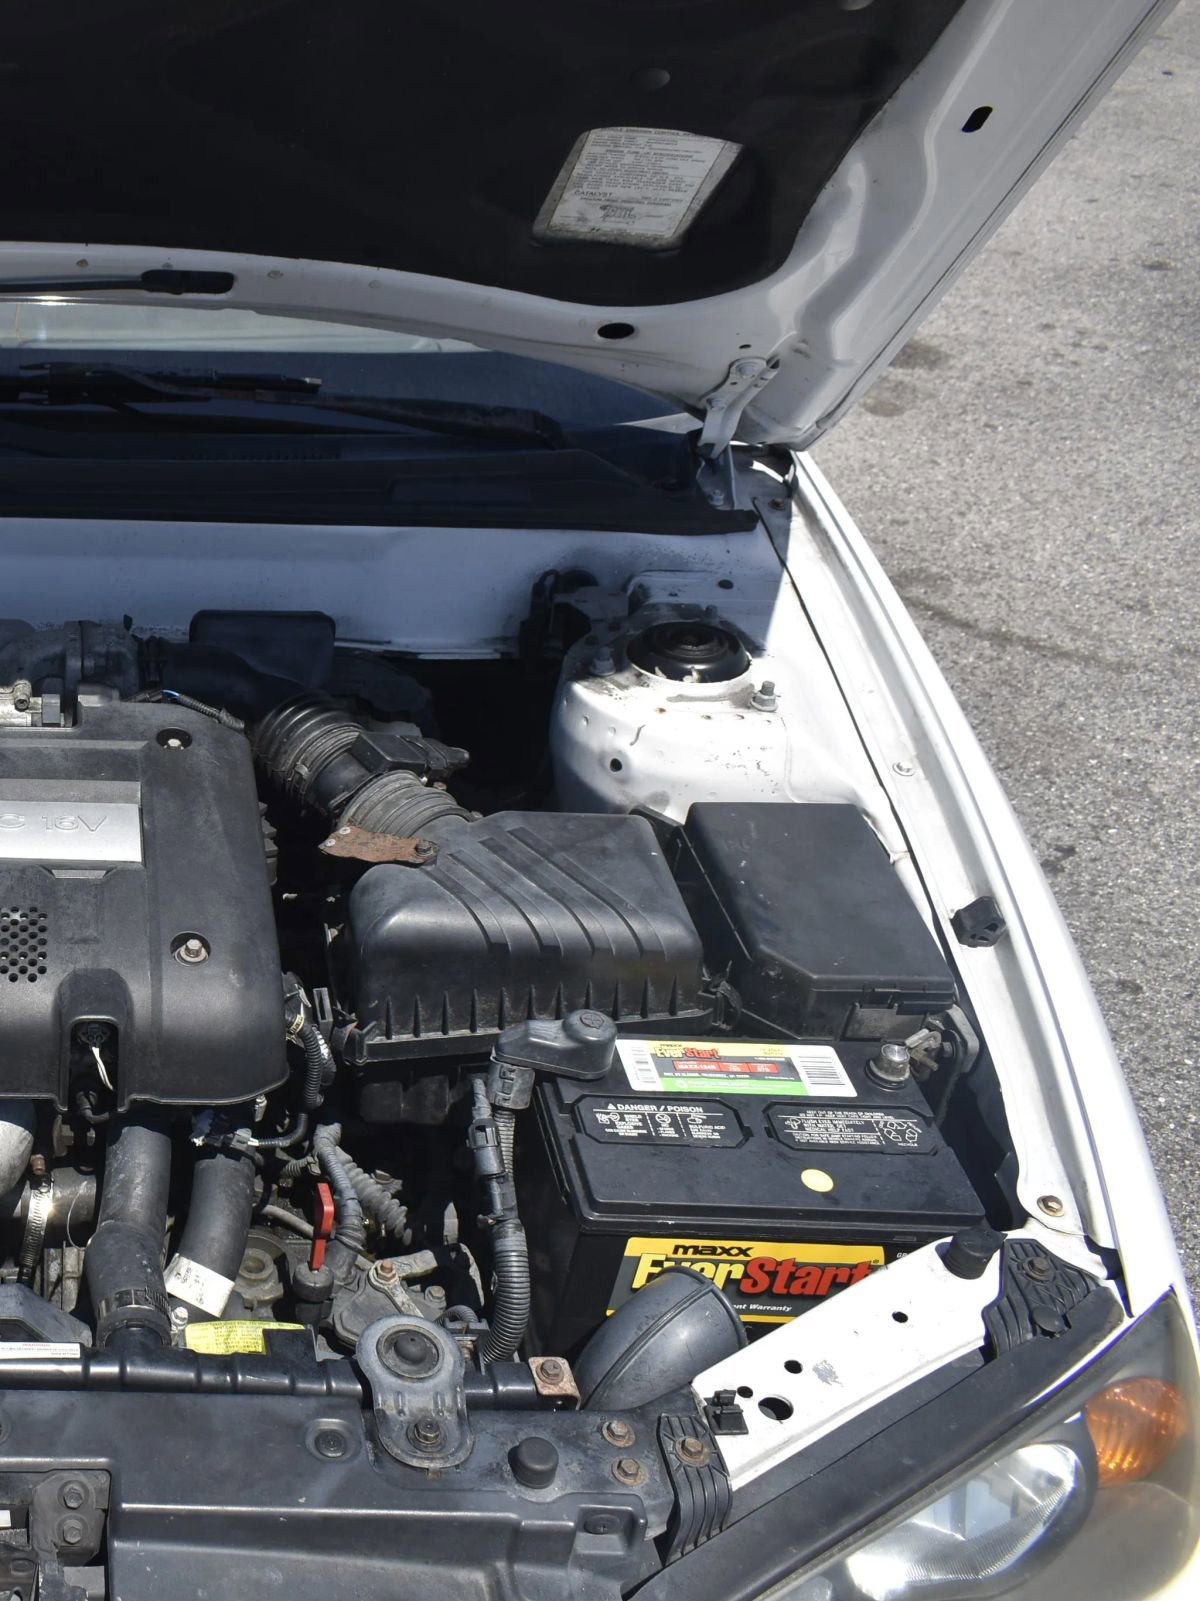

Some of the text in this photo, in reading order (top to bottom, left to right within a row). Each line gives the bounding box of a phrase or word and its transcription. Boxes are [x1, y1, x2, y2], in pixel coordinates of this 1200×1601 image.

[42, 815, 107, 832] 16V
[616, 1103, 657, 1112] DANGER
[667, 1105, 704, 1113] POISON
[672, 1244, 755, 1258] maxx
[749, 1303, 793, 1312] Warranty
